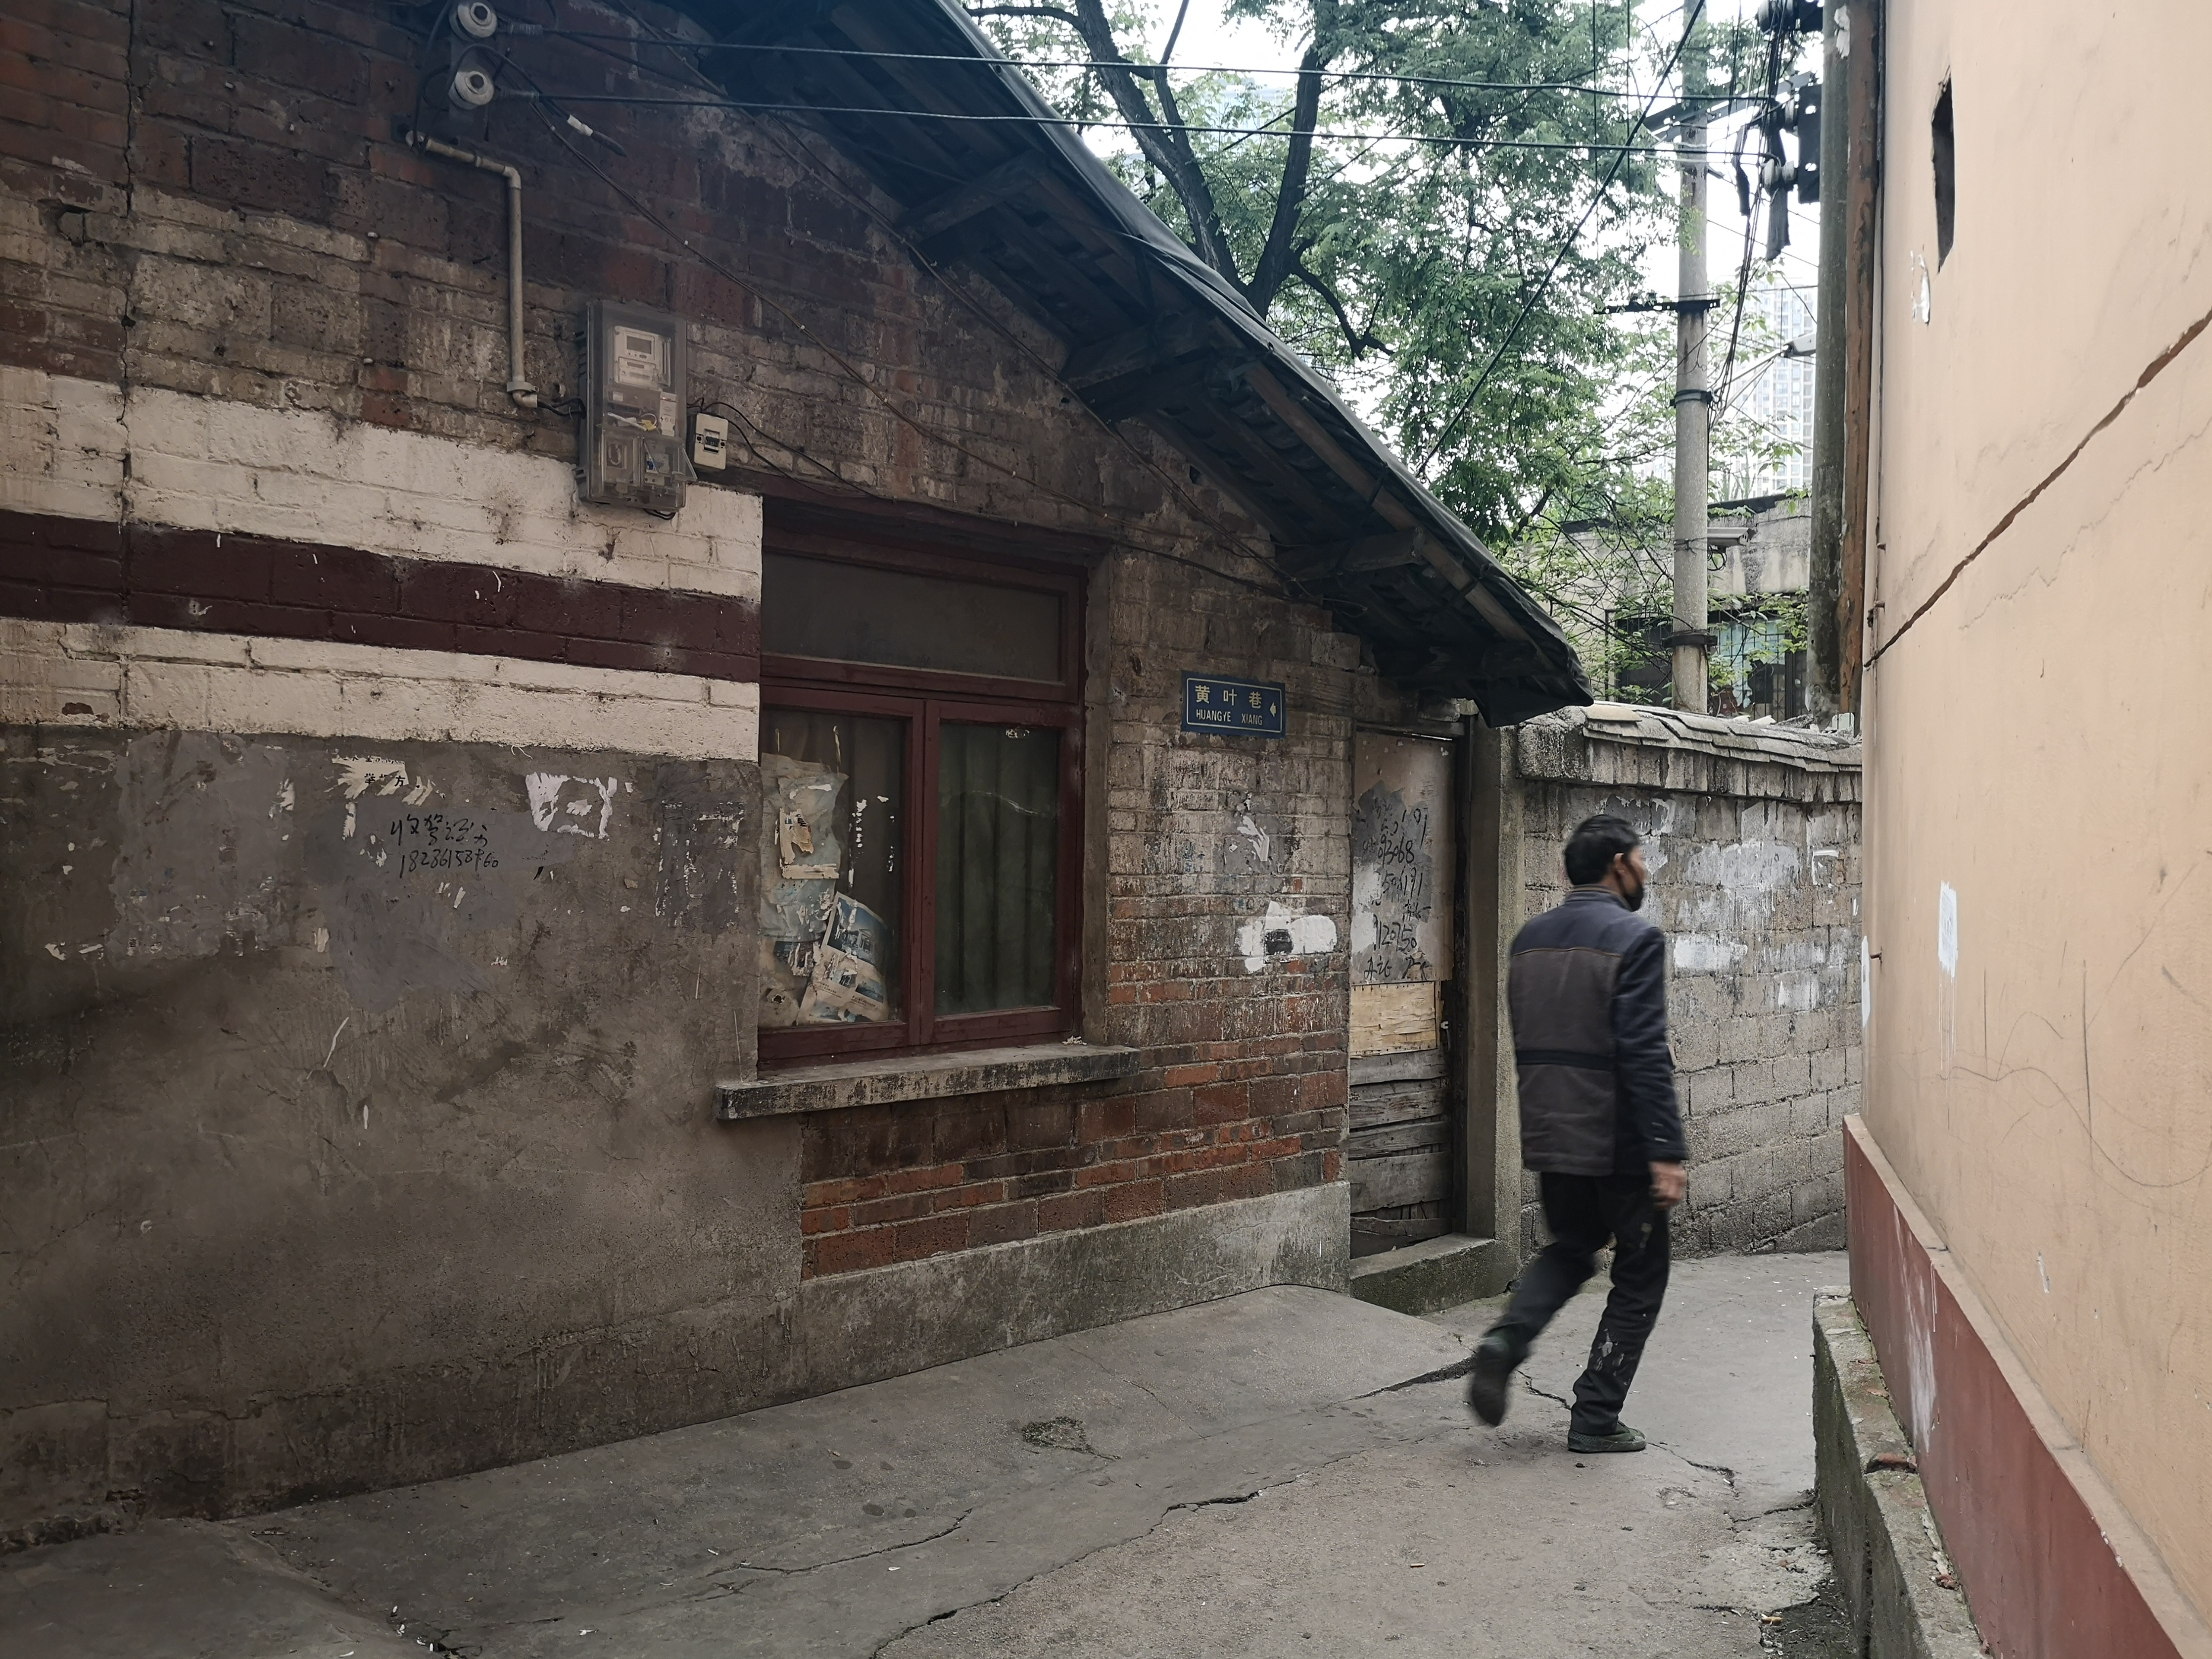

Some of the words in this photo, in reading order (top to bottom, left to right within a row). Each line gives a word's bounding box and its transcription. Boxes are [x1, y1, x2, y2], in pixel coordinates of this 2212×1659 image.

[1195, 685, 1262, 709] 黄叶巷
[1196, 709, 1231, 722] HUANGYE
[1241, 713, 1262, 725] XIANG
